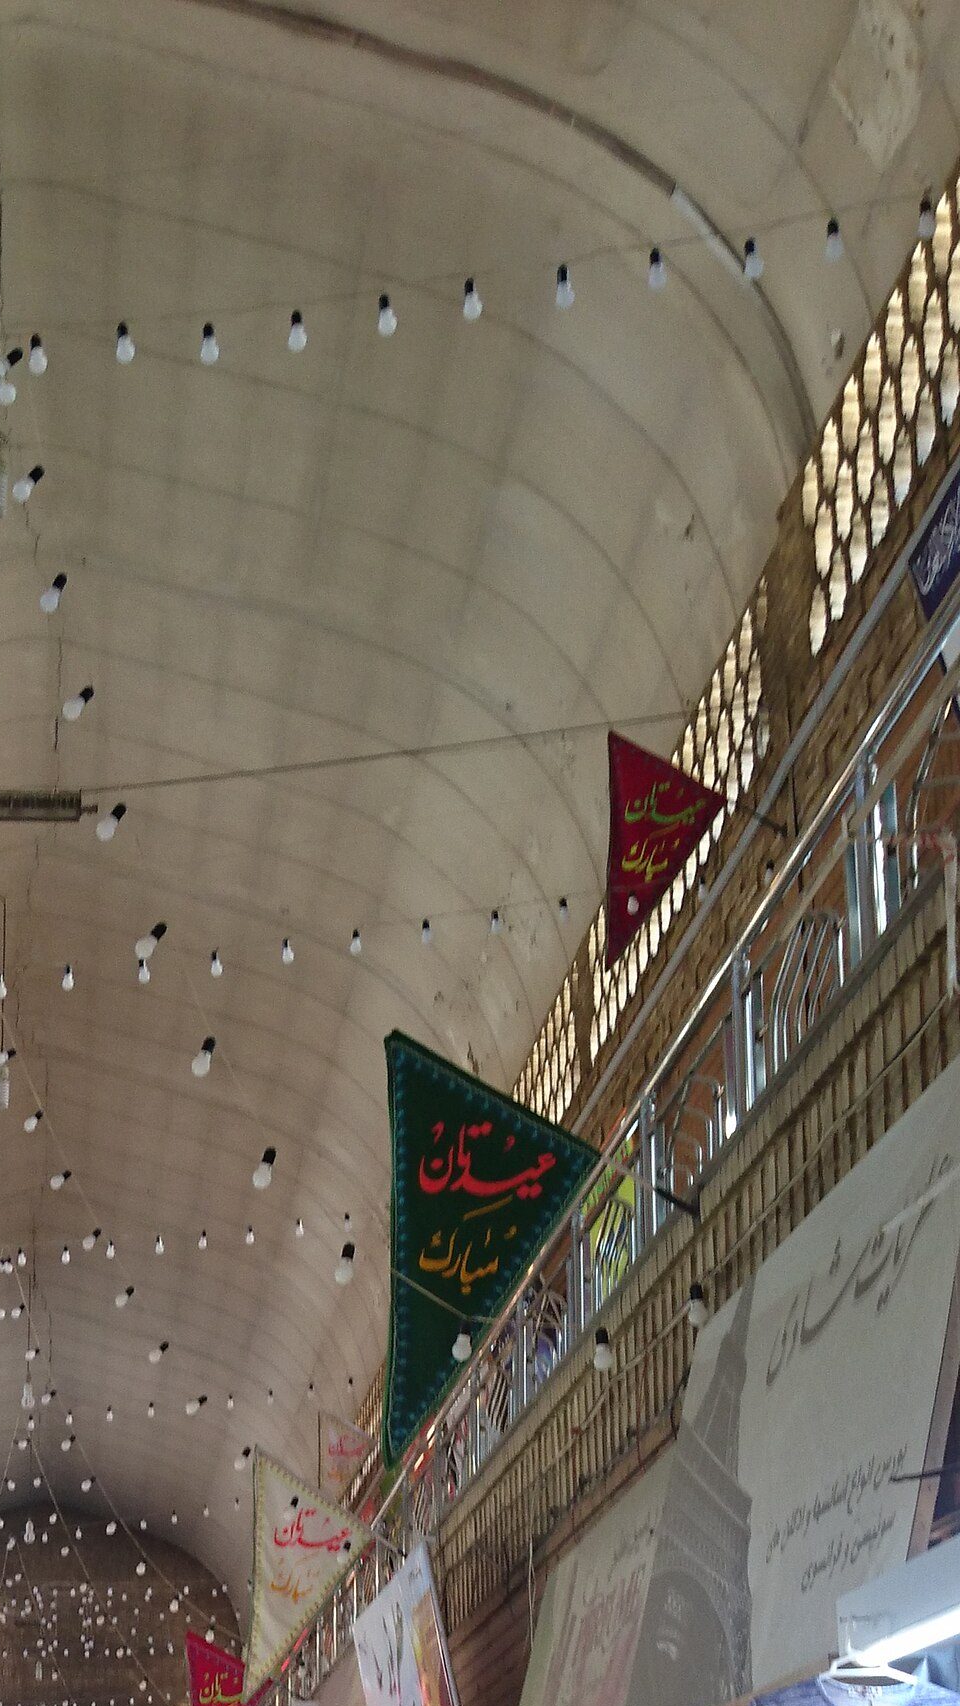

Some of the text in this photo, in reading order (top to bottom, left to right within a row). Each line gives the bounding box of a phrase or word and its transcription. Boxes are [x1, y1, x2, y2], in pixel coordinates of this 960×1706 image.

[625, 781, 707, 824] عیدتان
[622, 821, 681, 884] مبارک
[418, 1121, 558, 1200] عیدتان
[418, 1195, 514, 1295] مبارک
[274, 1507, 352, 1551] عیدتان
[270, 1550, 321, 1604] مبارک
